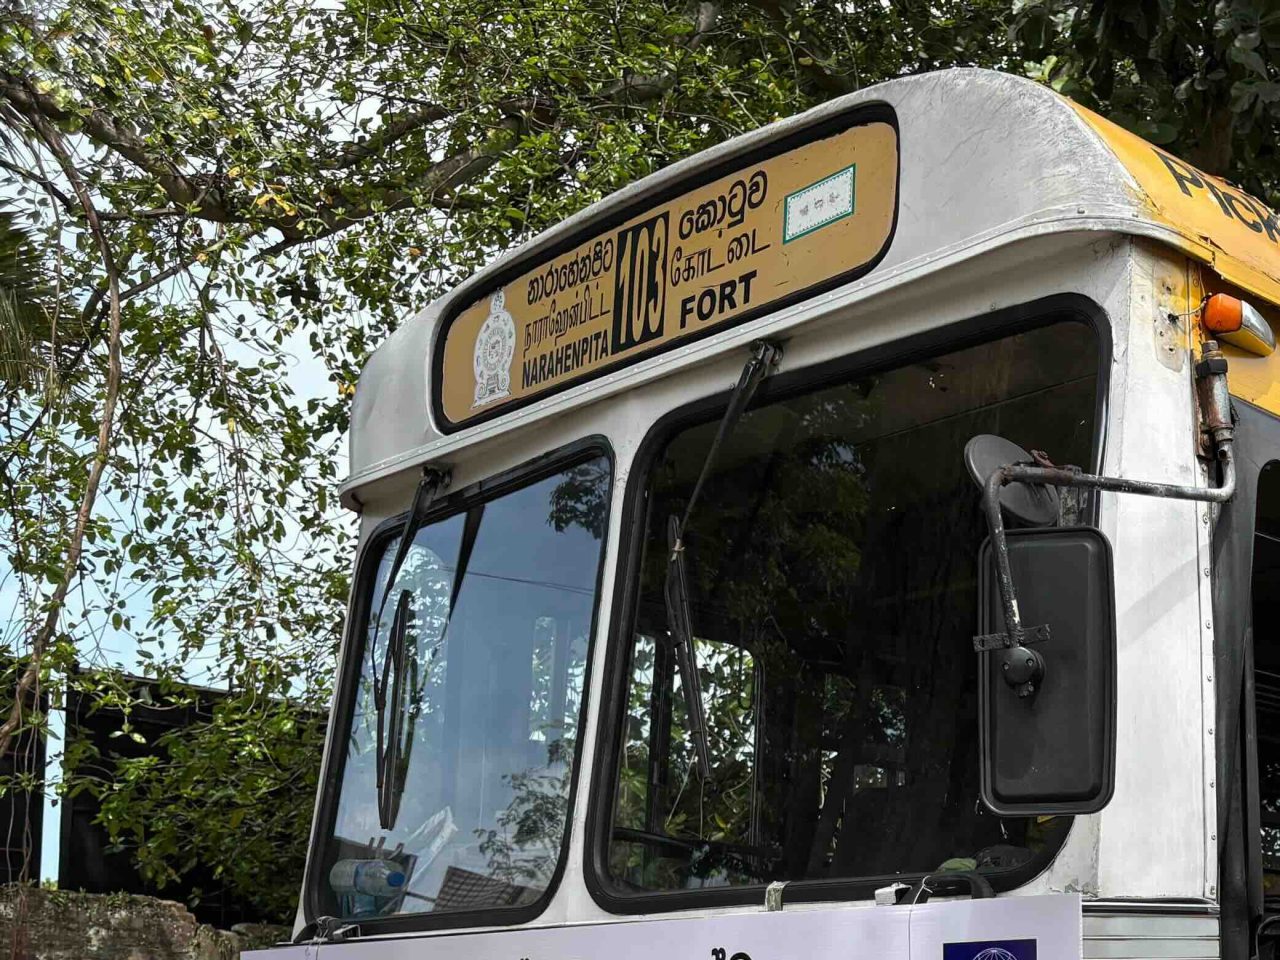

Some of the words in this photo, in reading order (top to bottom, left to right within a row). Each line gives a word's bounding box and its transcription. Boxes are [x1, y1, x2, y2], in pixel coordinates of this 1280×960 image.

[619, 217, 666, 346] 103
[680, 269, 758, 330] FORT
[521, 329, 609, 390] NARAHENPITA
